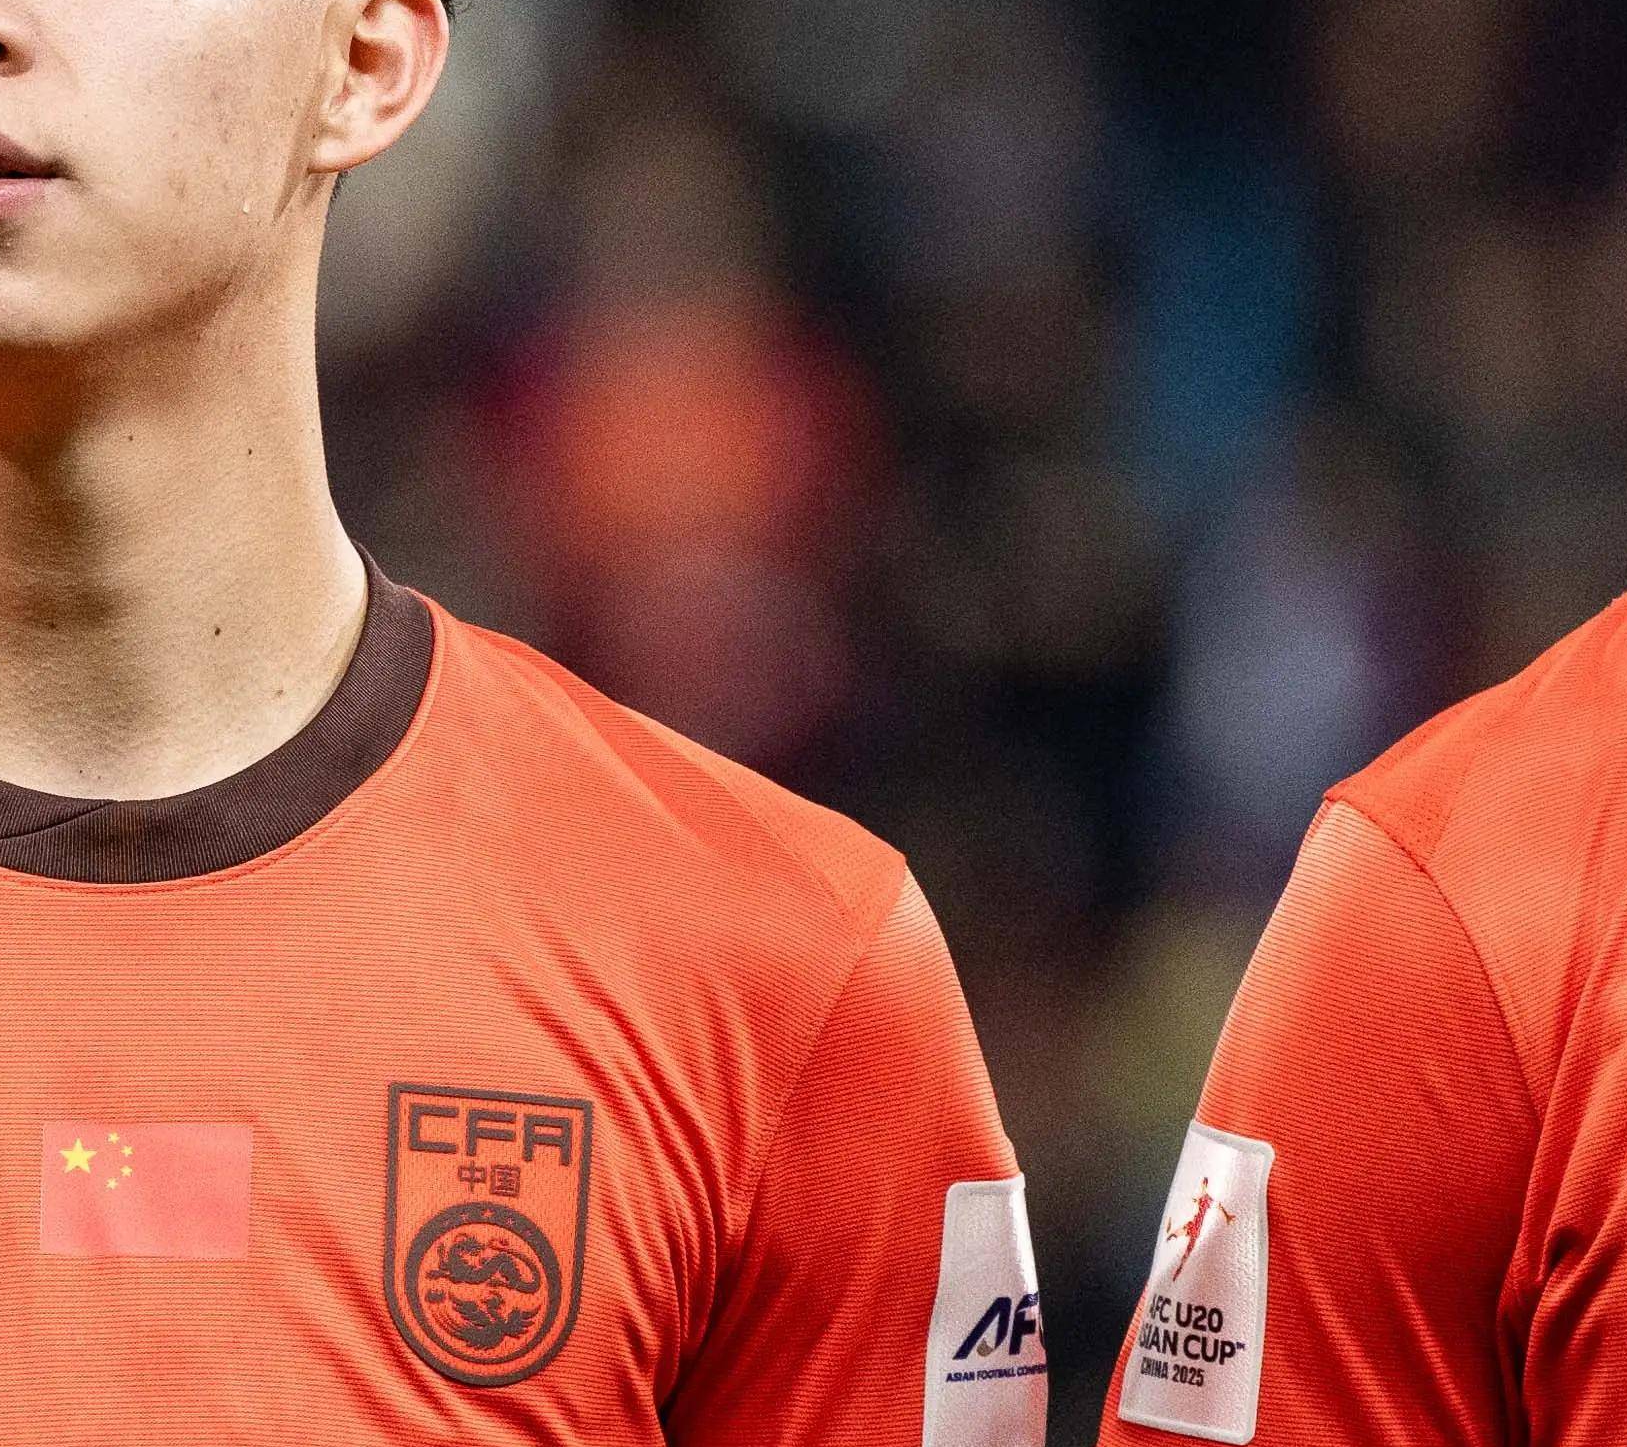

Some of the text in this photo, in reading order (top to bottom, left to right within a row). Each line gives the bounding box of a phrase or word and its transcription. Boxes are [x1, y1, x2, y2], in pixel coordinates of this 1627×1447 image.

[409, 1104, 573, 1166] CFA
[458, 1161, 521, 1198] 中国
[1176, 1301, 1223, 1333] U20
[946, 1371, 976, 1382] ASIAN
[977, 1367, 1017, 1381] FOOTBALL
[1172, 1363, 1205, 1387] 2025
